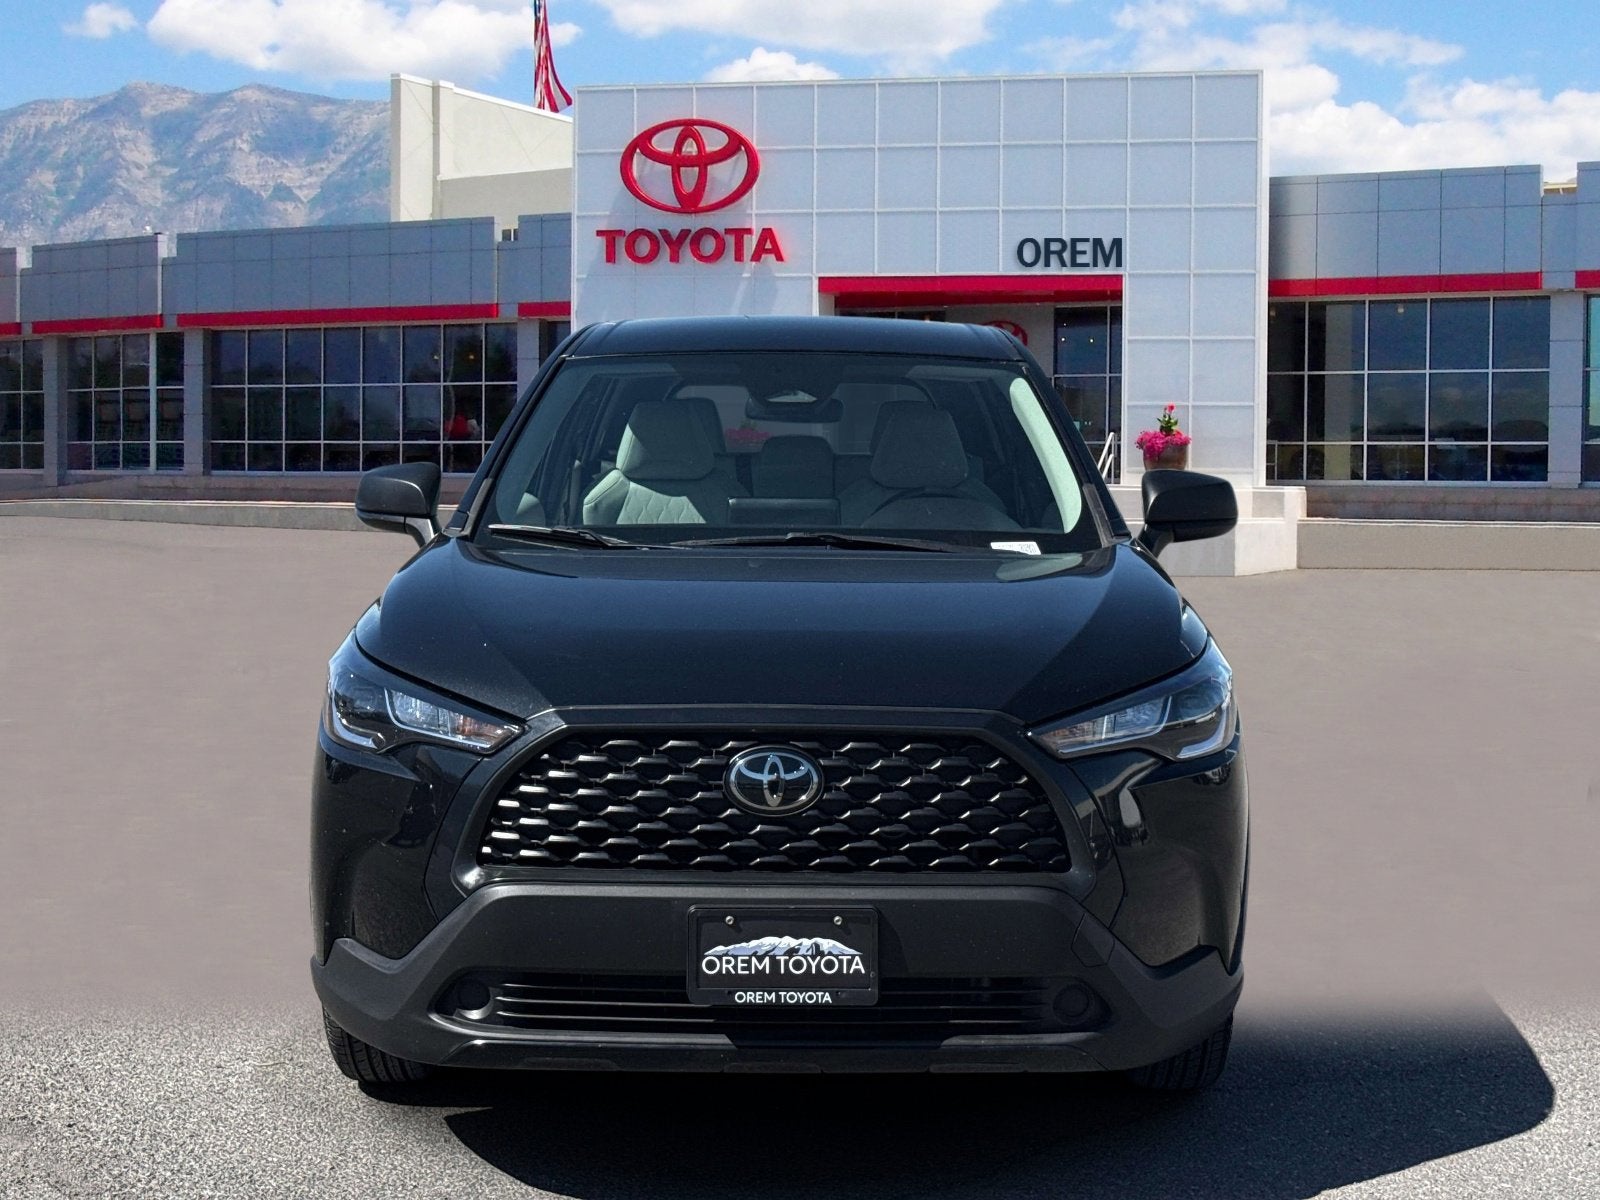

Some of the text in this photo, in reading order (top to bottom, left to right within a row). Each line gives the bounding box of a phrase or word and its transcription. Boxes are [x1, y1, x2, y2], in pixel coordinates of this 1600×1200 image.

[596, 227, 785, 265] TOYOTA
[1016, 237, 1123, 268] OREM
[701, 955, 866, 975] OREM TOYOTA
[734, 991, 832, 1004] OREM TOYOTA
